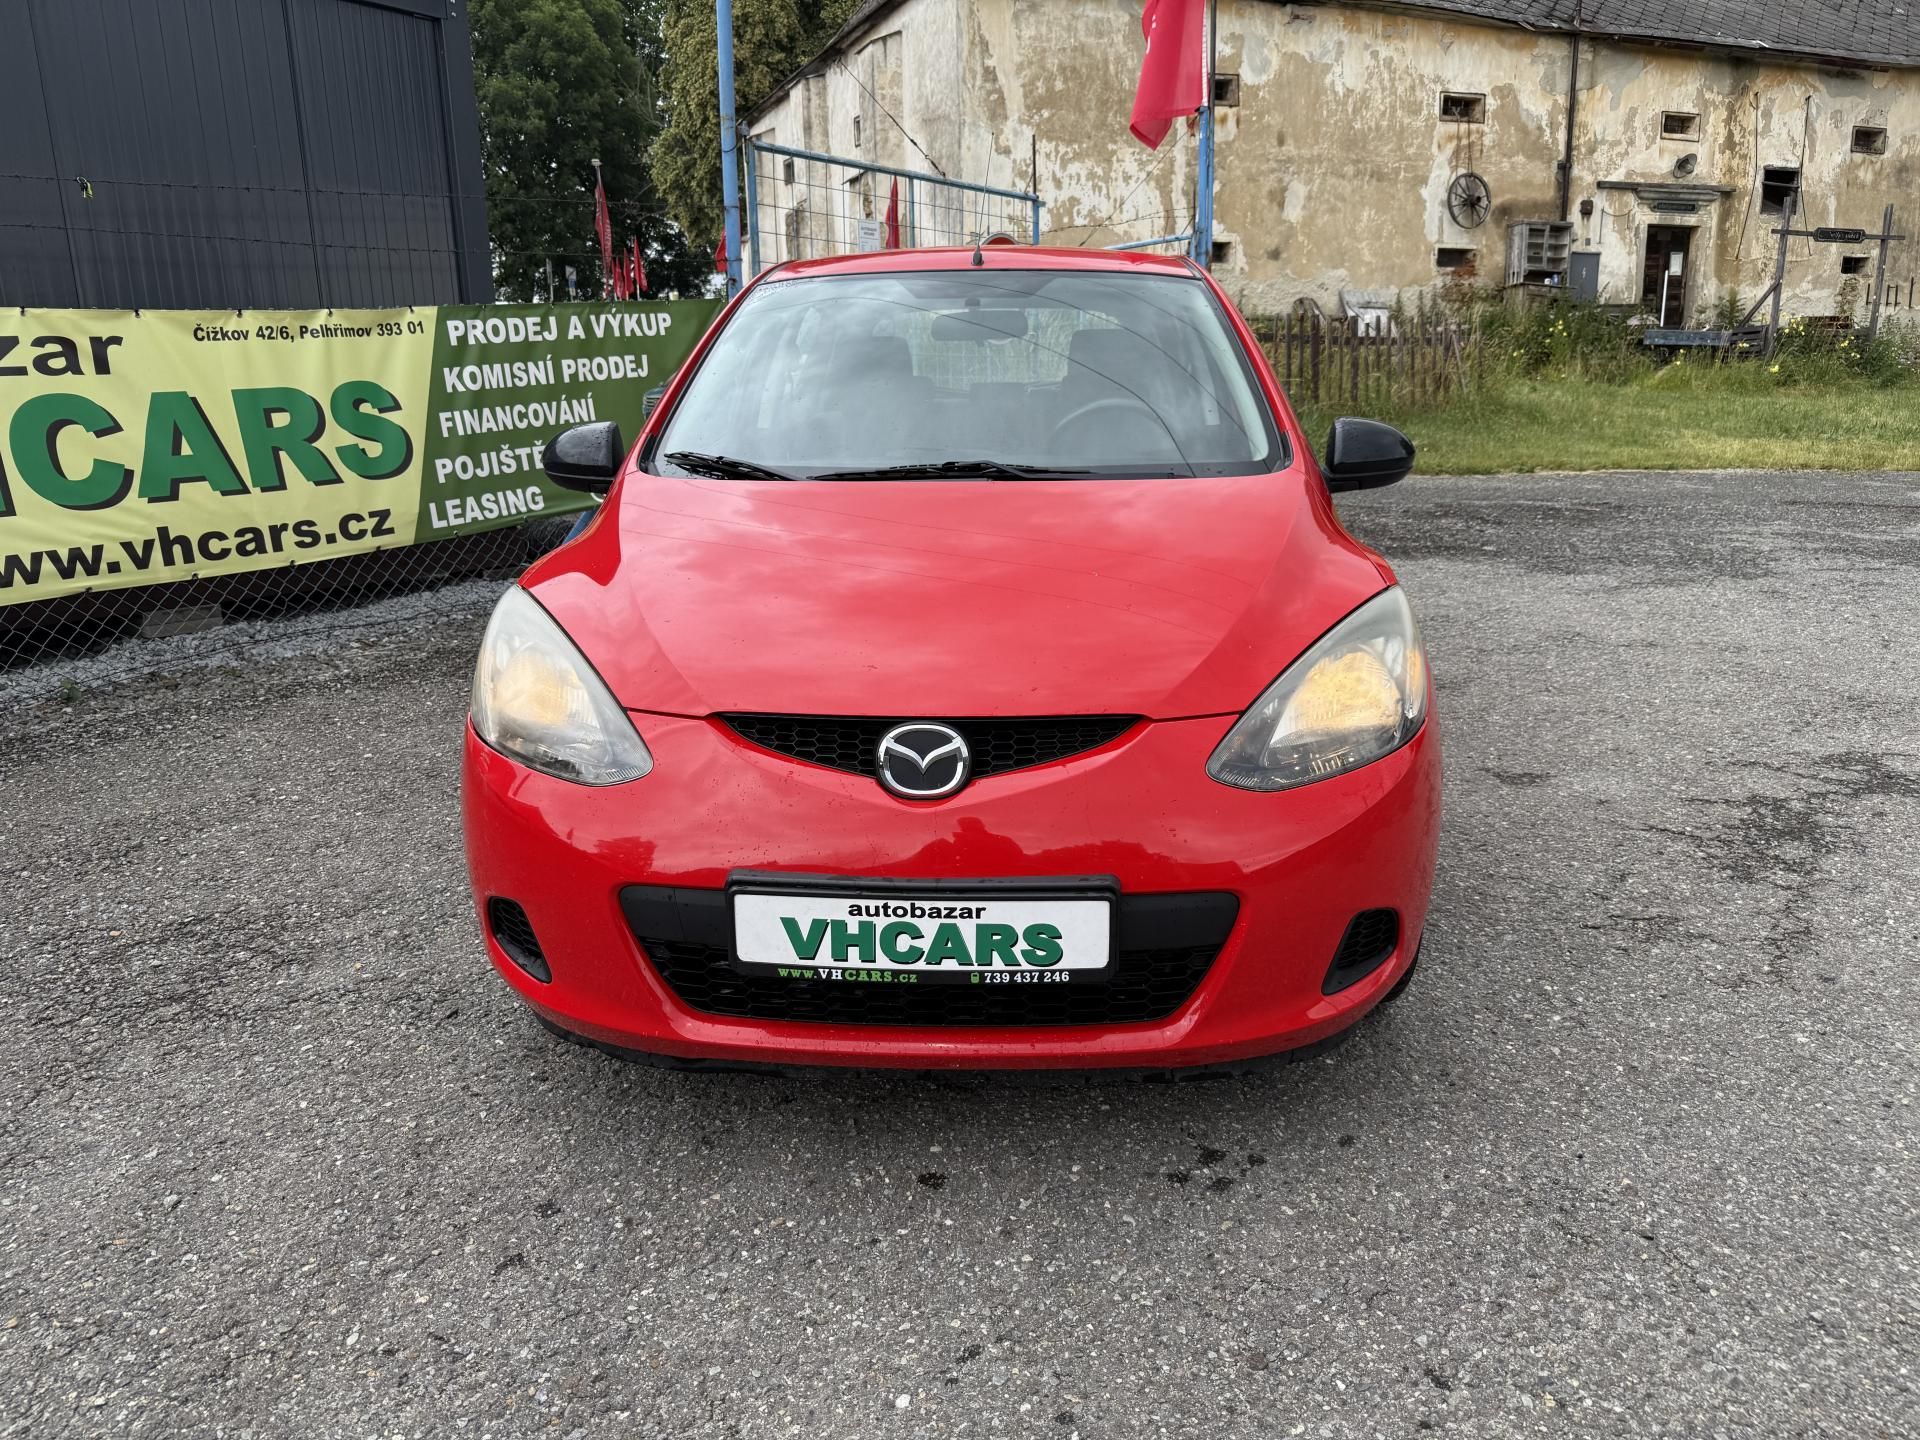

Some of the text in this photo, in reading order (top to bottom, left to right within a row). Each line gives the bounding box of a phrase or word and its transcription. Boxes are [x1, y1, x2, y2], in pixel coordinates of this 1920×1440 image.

[193, 320, 424, 342] Čížkov 42/6, Pelhřimov 393 01
[446, 309, 672, 346] PRODEJ A VÝKUP
[443, 354, 649, 393] KOMISNÍ PRODEJ
[439, 392, 597, 438] FINANCOVÁNÍ
[0, 380, 413, 517] CARS
[429, 486, 545, 529] LEASING
[848, 902, 987, 919] autobazar
[780, 917, 1064, 967] VHCARS
[778, 968, 1070, 983] www.VHCARS.cz 739 437 246
